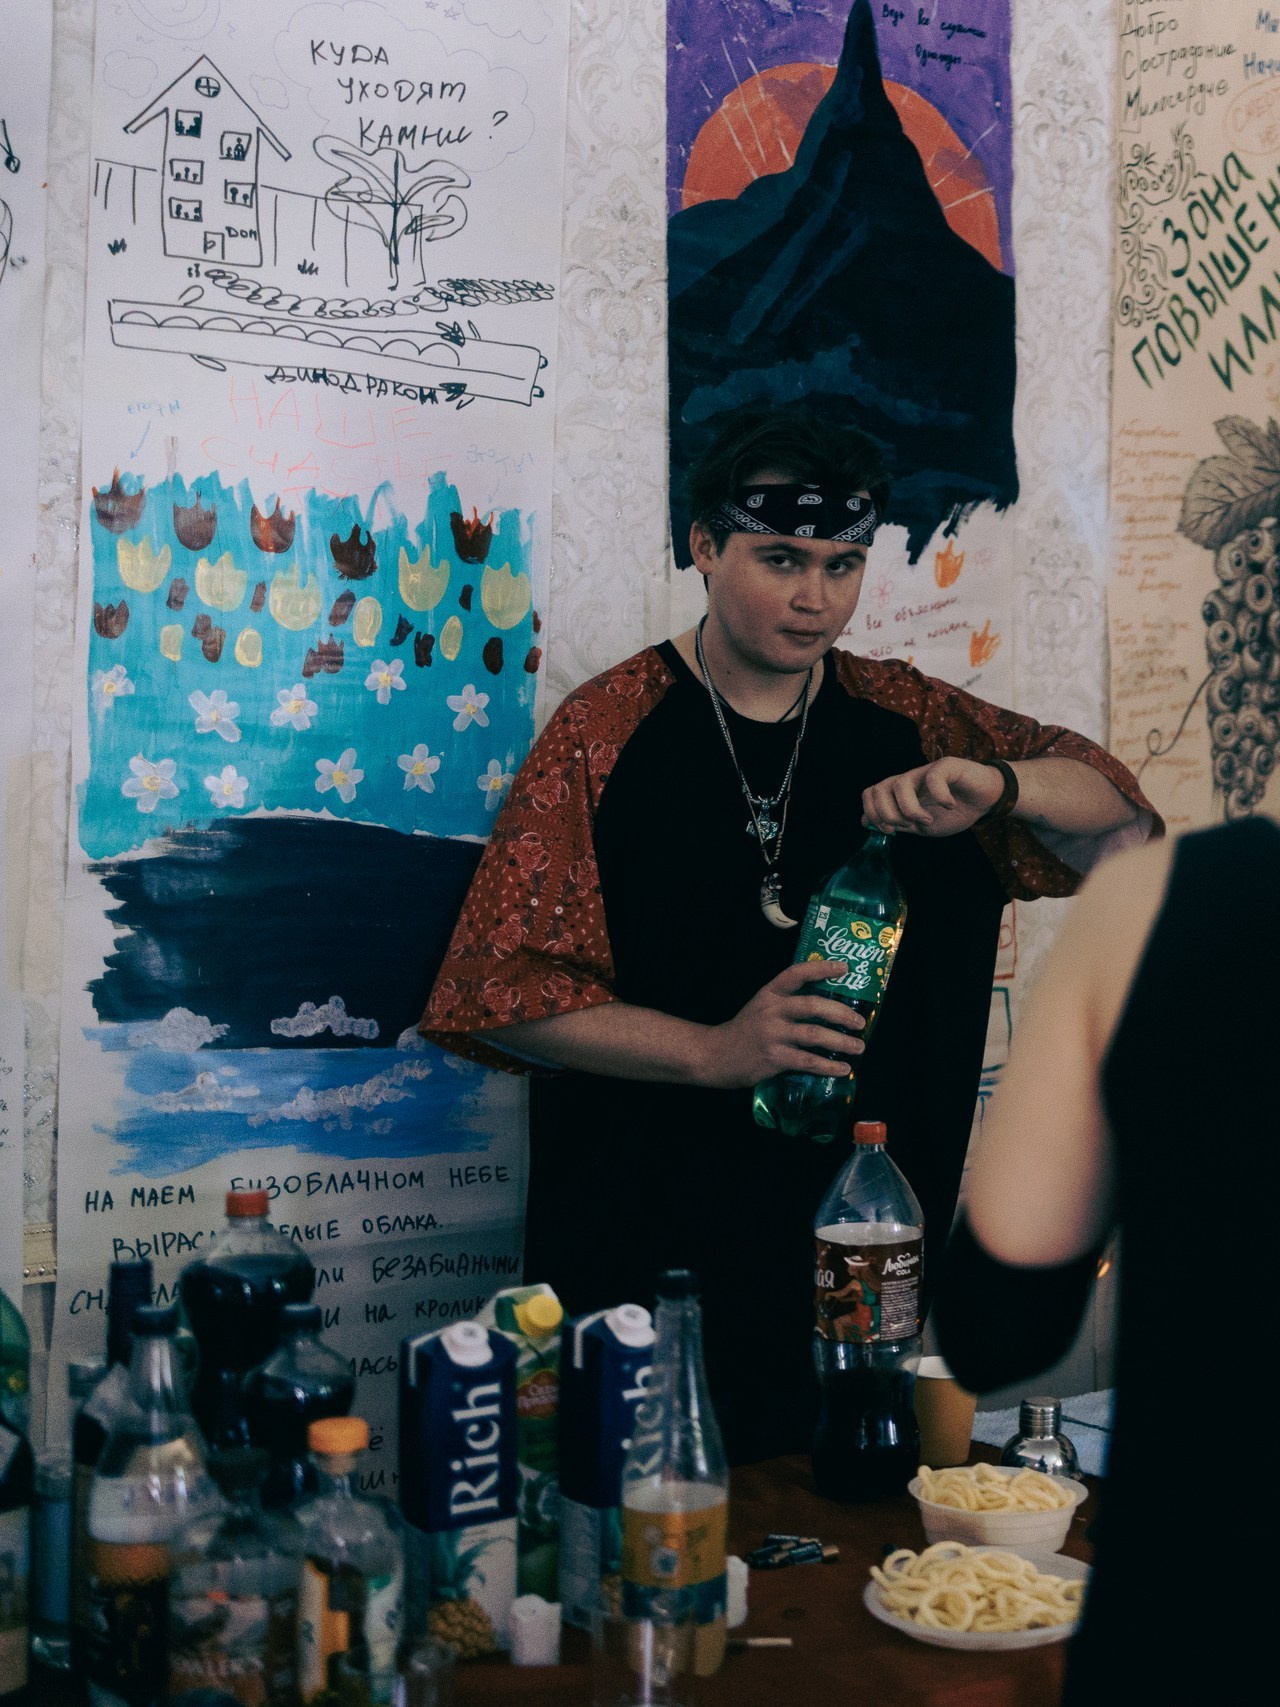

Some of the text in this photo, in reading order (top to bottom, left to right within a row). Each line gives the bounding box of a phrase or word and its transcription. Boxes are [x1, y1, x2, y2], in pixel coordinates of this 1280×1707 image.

[1121, 10, 1180, 45] Добро
[310, 39, 389, 66] КУДА
[338, 78, 468, 104] УХОДЯТ
[228, 377, 434, 449] НАШЕ
[817, 925, 886, 963] Lemon
[855, 960, 870, 977] &
[85, 1191, 115, 1213] НА
[131, 1185, 195, 1207] МАЕМ
[449, 1166, 510, 1184] НЕБЕ
[113, 1230, 206, 1261] ВЫРАС
[276, 1220, 341, 1242] ЕЛЫЕ
[414, 1299, 488, 1318] КРОЛИК
[621, 1364, 664, 1480] Rich
[450, 1382, 500, 1518] Rich
